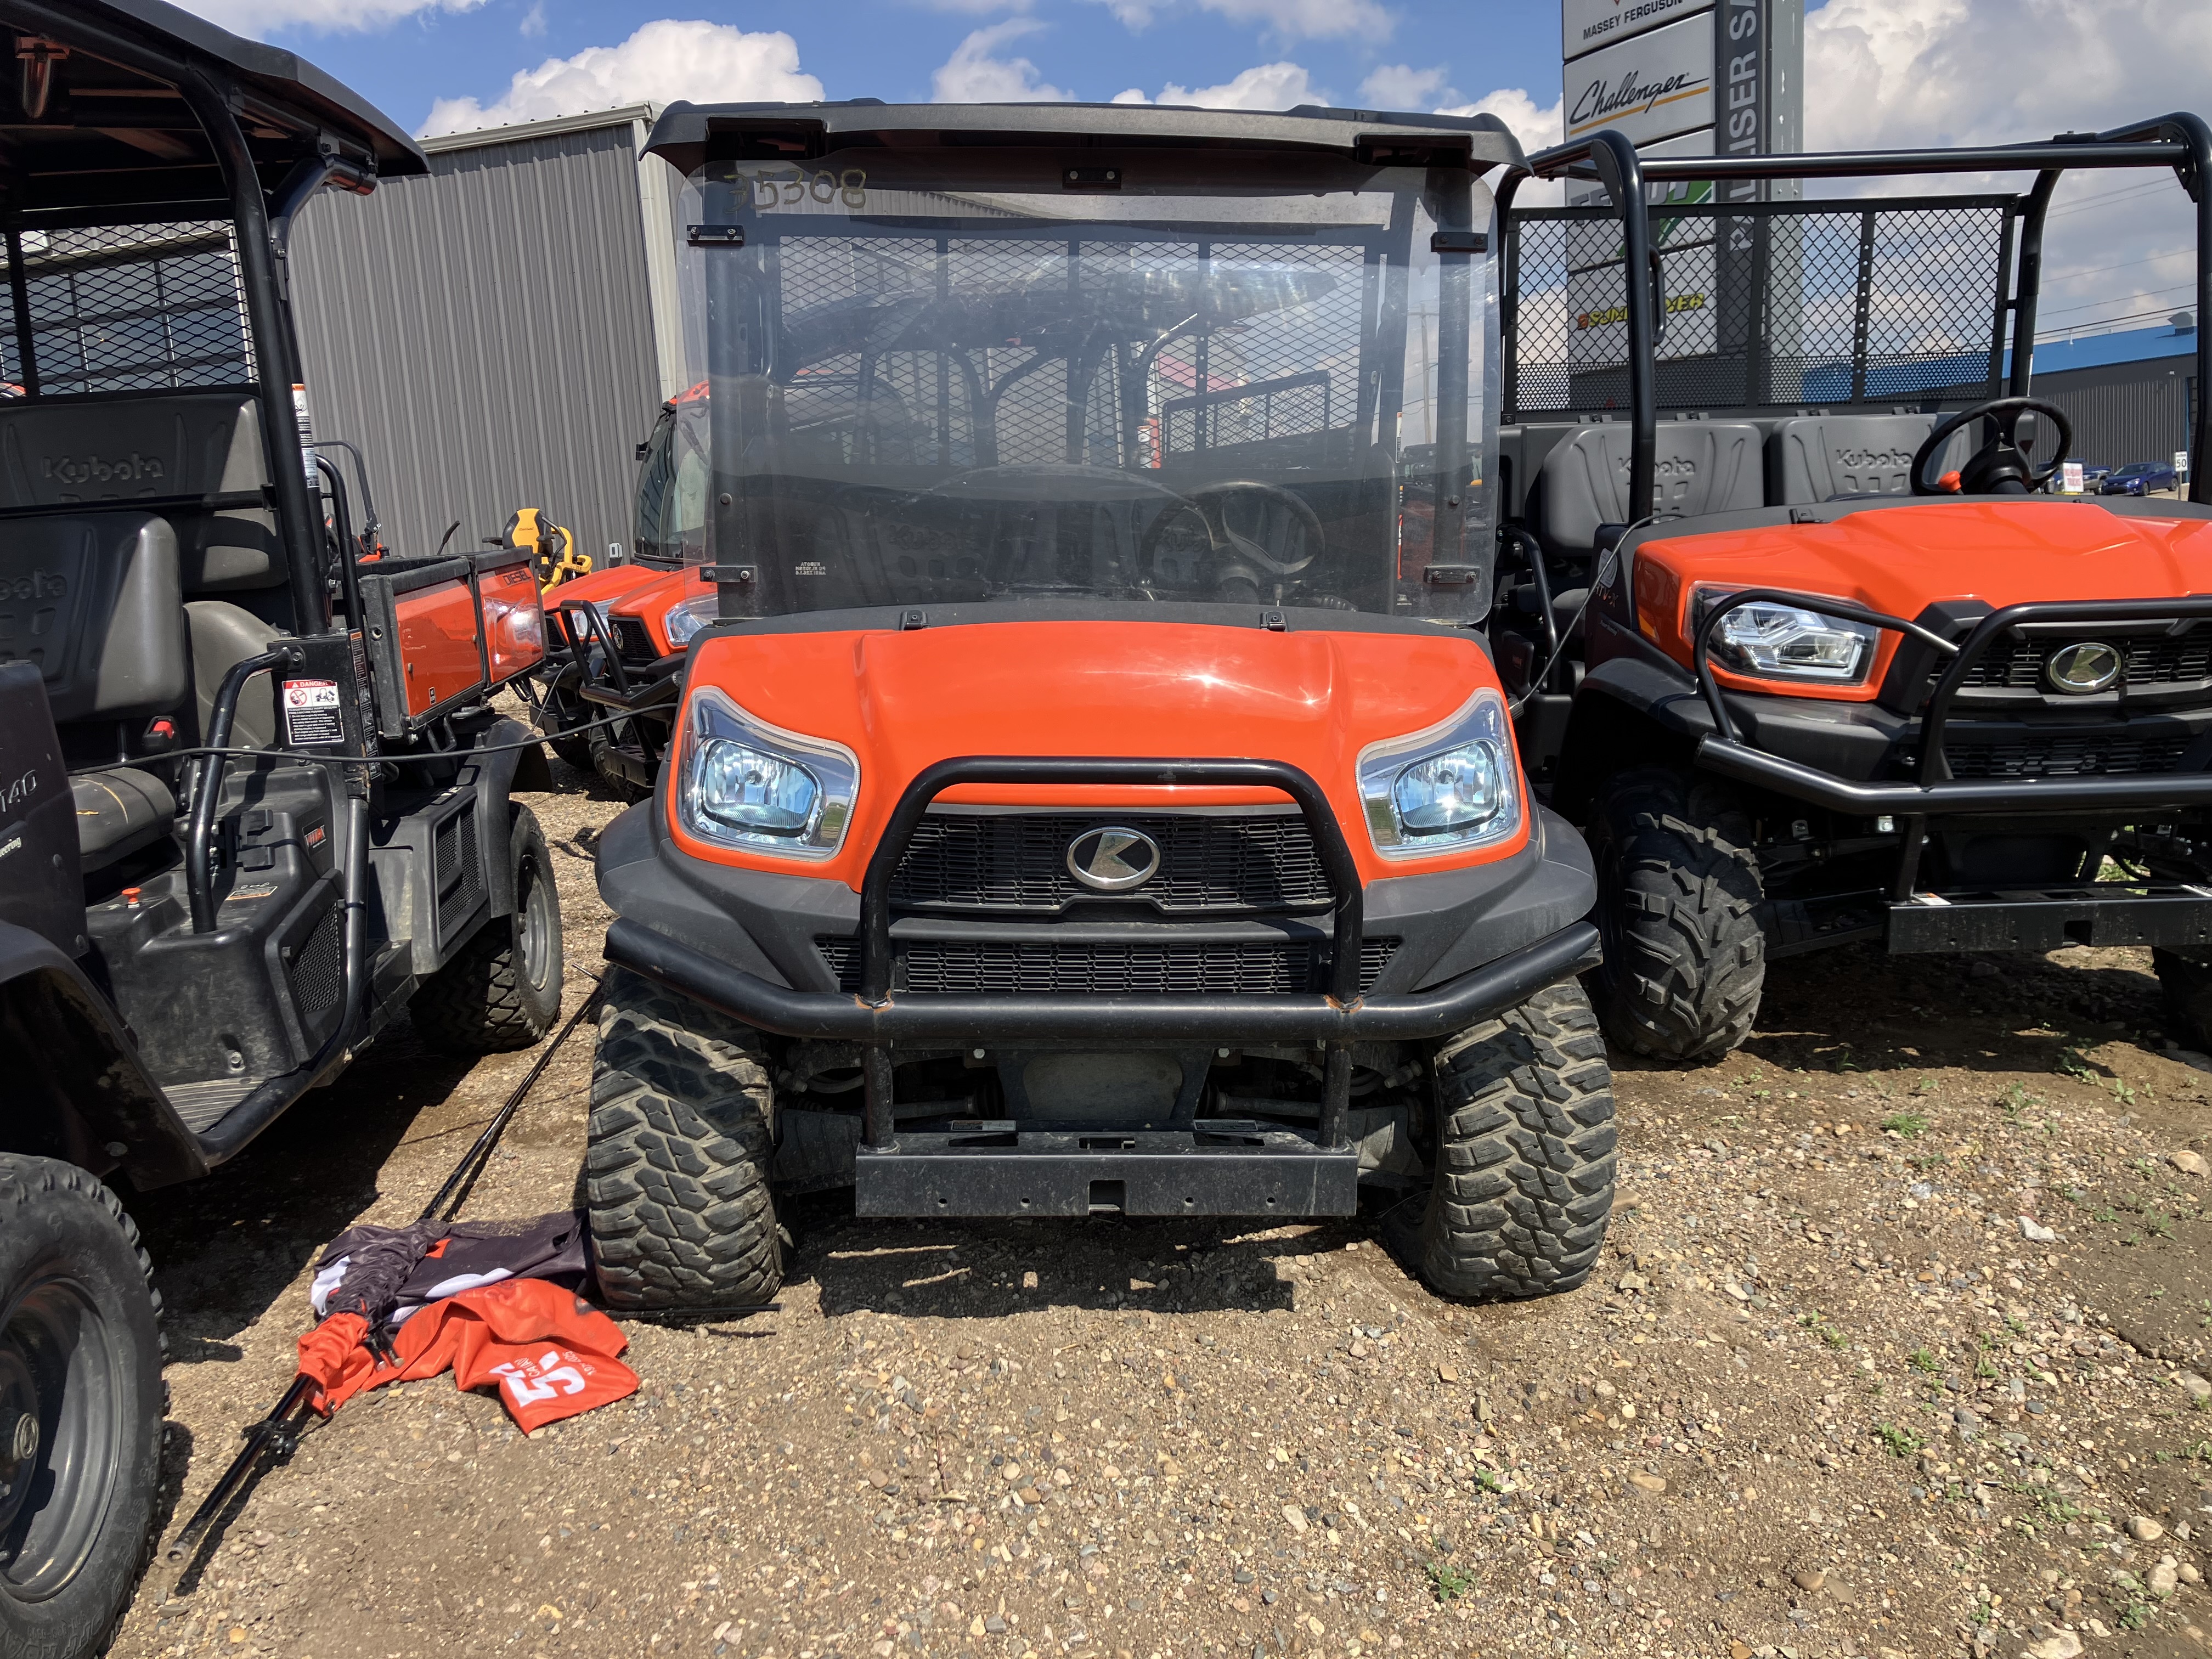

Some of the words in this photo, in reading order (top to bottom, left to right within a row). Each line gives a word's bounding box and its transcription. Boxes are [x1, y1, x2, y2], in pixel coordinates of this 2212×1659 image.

[1583, 14, 1621, 40] MASSEY
[1729, 0, 1757, 41] S
[1570, 70, 1709, 124] Challenger
[722, 168, 867, 215] 35308
[41, 451, 165, 484] Kubota
[1618, 456, 1696, 476] Kota
[1836, 448, 1913, 469] Kubota
[2176, 459, 2187, 468] 50
[503, 570, 532, 586] DIESEL
